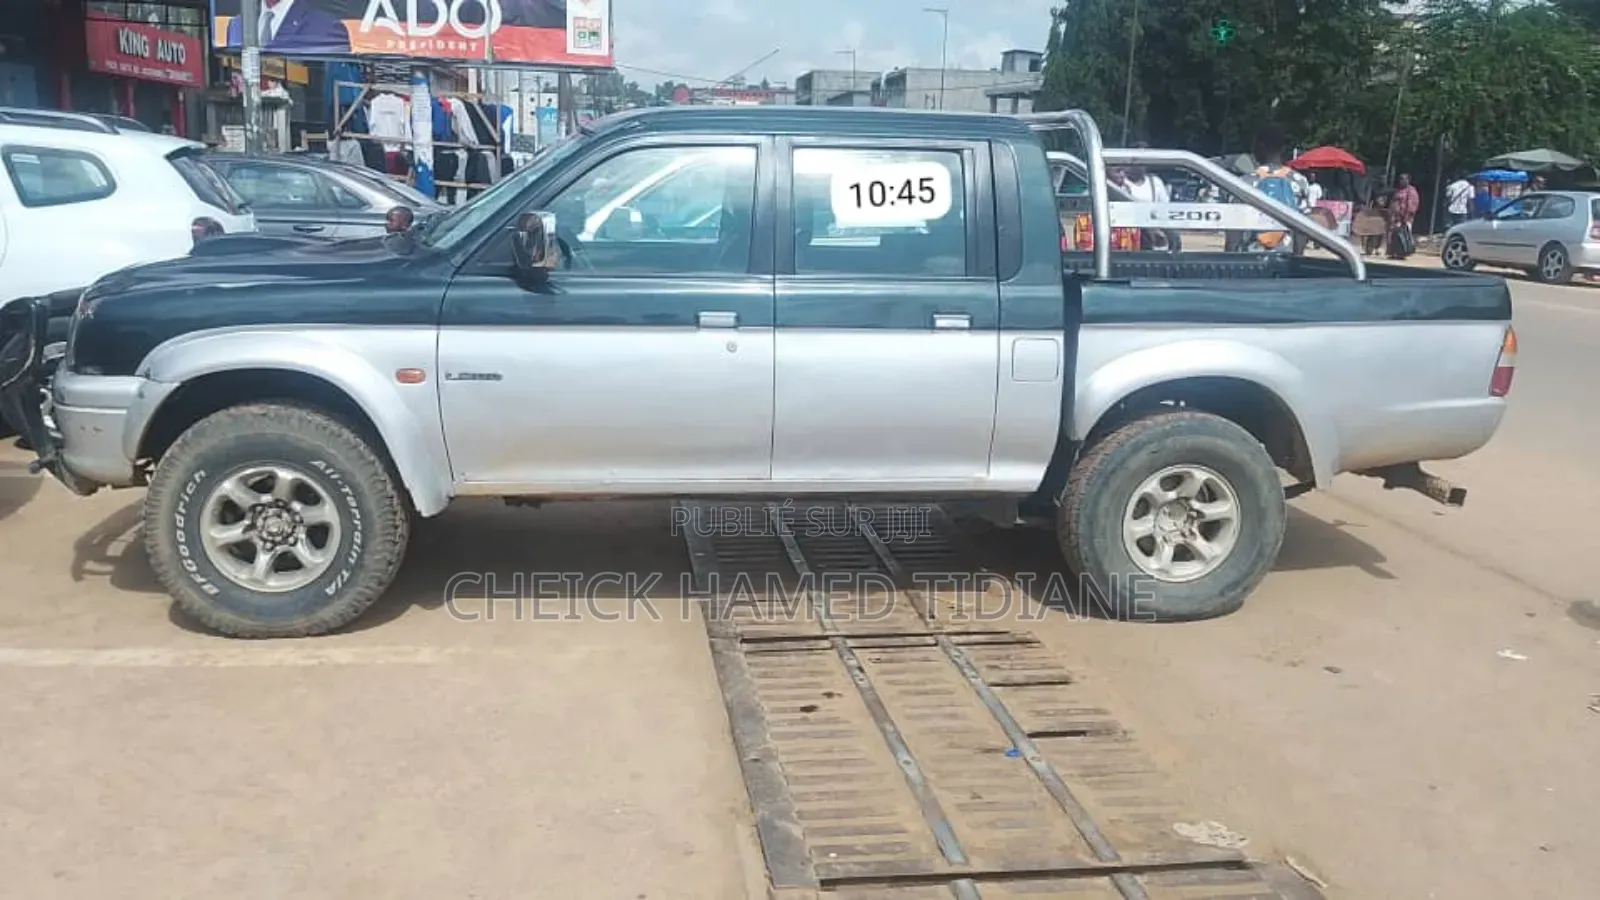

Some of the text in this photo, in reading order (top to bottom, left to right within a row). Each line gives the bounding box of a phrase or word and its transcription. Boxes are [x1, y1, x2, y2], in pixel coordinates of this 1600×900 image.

[360, 0, 502, 38] ADO
[119, 27, 186, 65] KING AUTO
[174, 469, 220, 595] BFGoodrich
